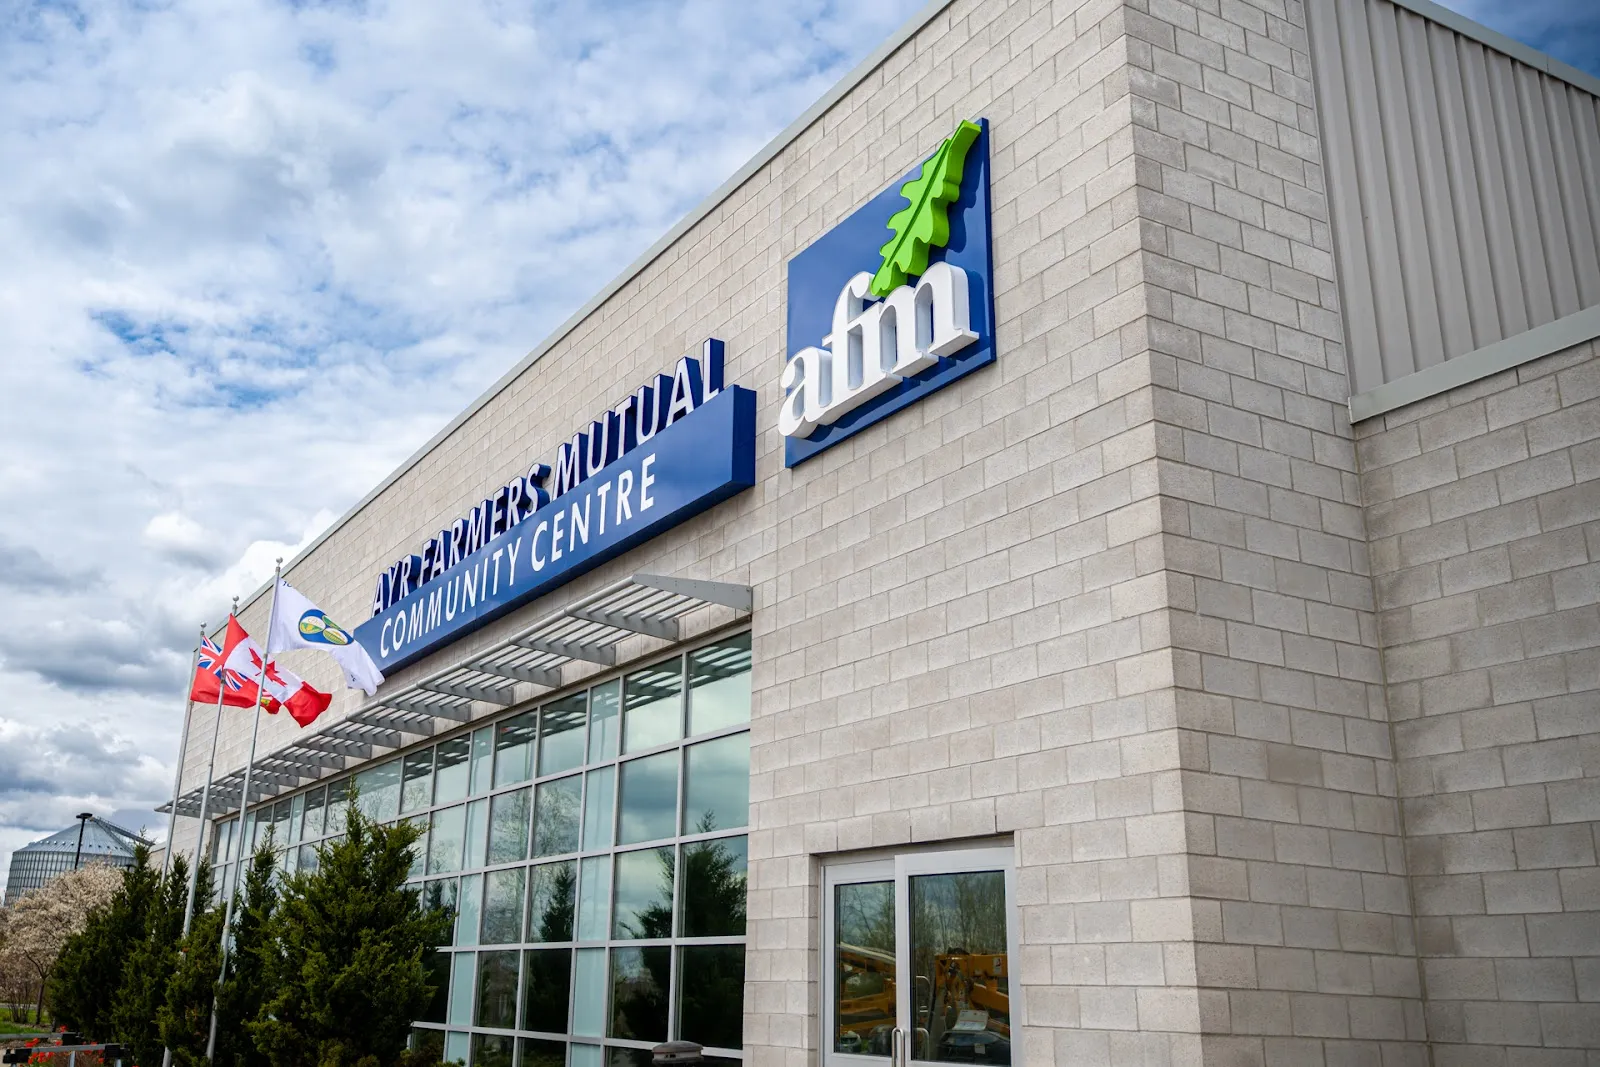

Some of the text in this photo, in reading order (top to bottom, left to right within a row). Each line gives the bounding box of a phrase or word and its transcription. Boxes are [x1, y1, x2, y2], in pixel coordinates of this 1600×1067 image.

[778, 262, 979, 438] afm
[372, 338, 724, 618] AYR FARMERS MUTUAL
[380, 453, 656, 658] COMMUNITY CENTRE
